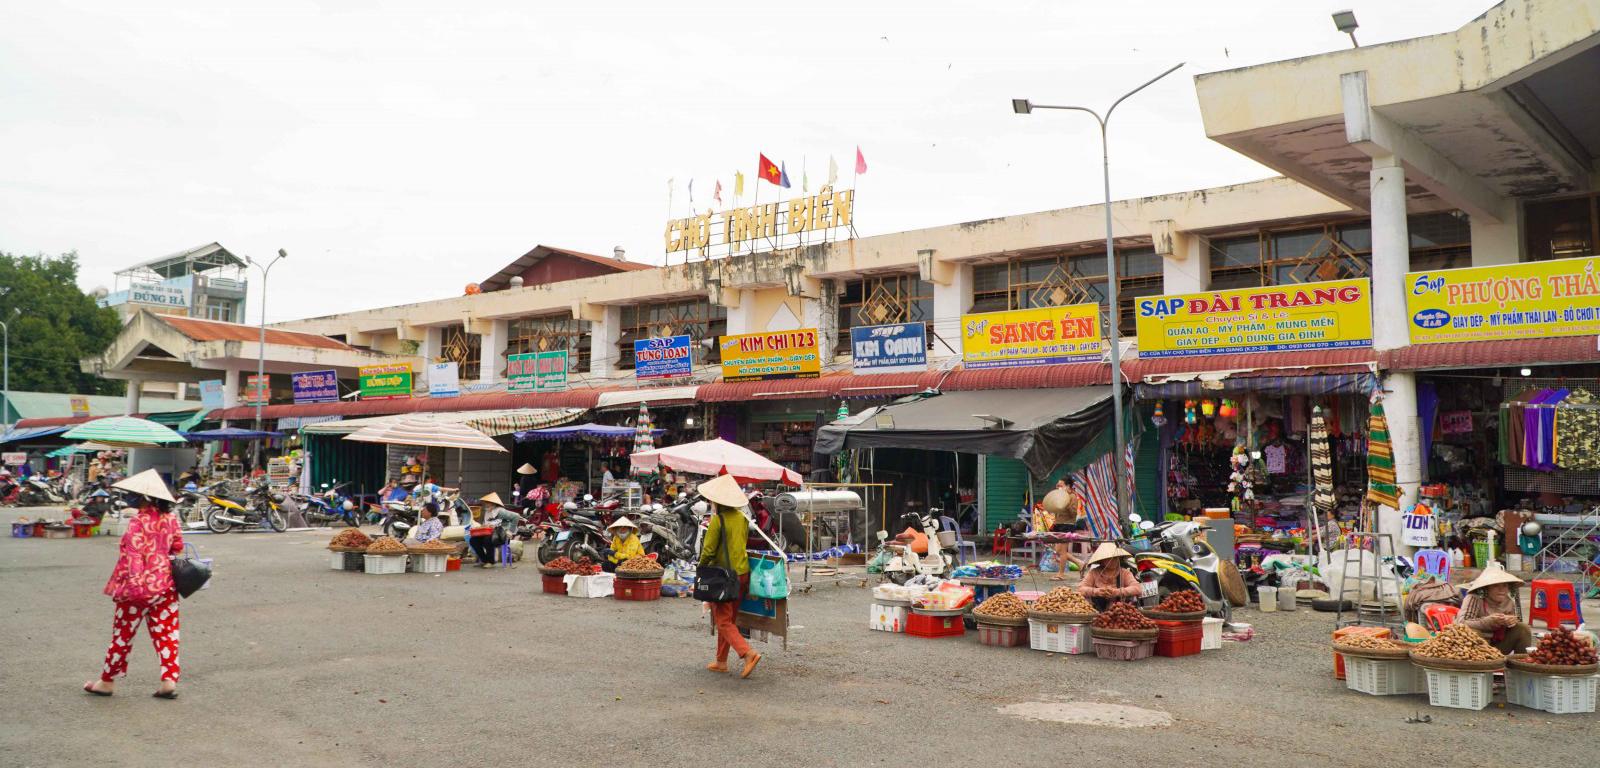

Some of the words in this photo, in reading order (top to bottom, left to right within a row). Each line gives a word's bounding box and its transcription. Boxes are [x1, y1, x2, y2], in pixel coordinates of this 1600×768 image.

[1447, 277, 1542, 308] PHƯỢNG
[1548, 260, 1600, 298] THẮ
[1140, 298, 1185, 320] SẠP
[1188, 294, 1241, 315] ĐÀI
[1248, 286, 1361, 310] TRANG
[1543, 310, 1557, 323] LAN
[740, 336, 764, 352] KIM
[766, 334, 788, 350] CHI
[790, 332, 815, 348] 123
[989, 319, 1056, 345] SANG
[1278, 332, 1296, 341] GIA
[855, 339, 880, 358] KIM
